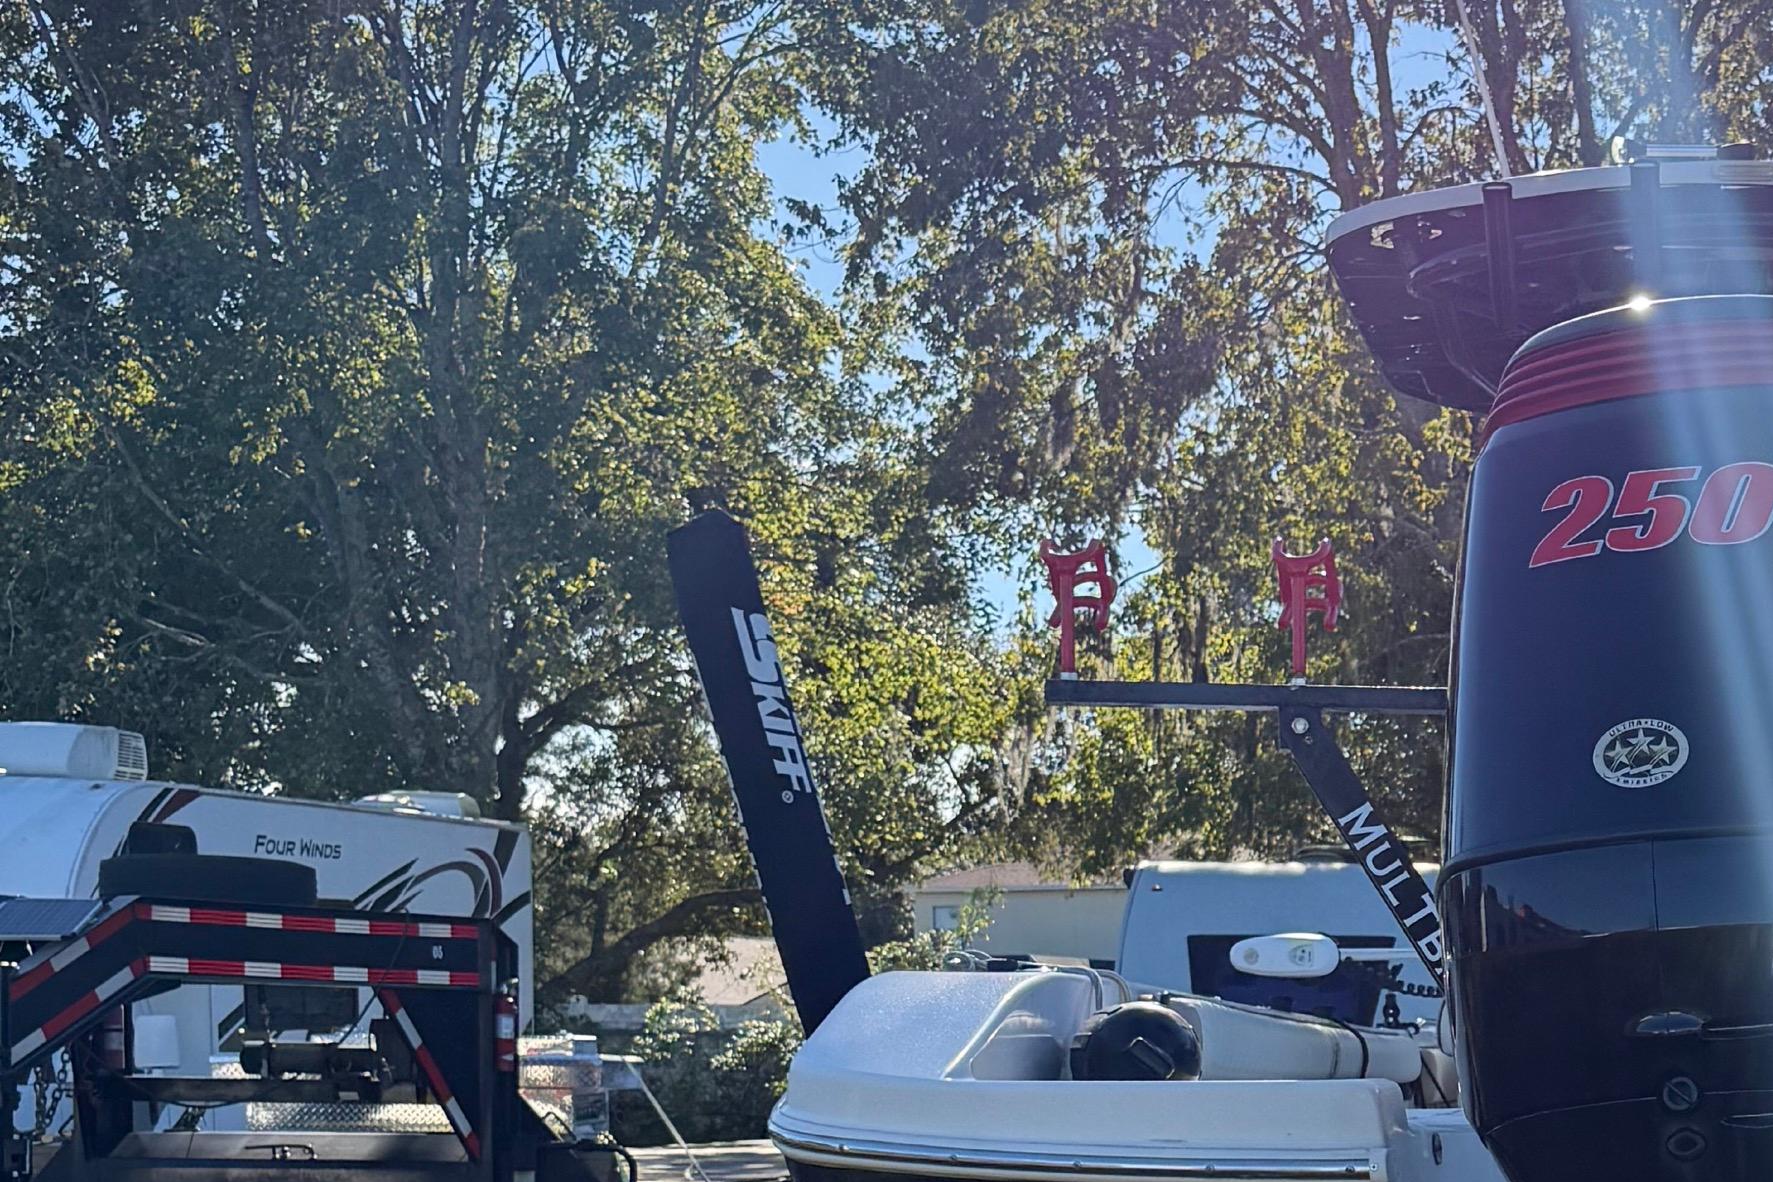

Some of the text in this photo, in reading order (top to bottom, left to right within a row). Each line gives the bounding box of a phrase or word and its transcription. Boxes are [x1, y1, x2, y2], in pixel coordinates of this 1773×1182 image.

[1650, 720, 1674, 732] LOW
[254, 834, 343, 860] FOUR WINDS
[1338, 801, 1444, 976] MULTB
